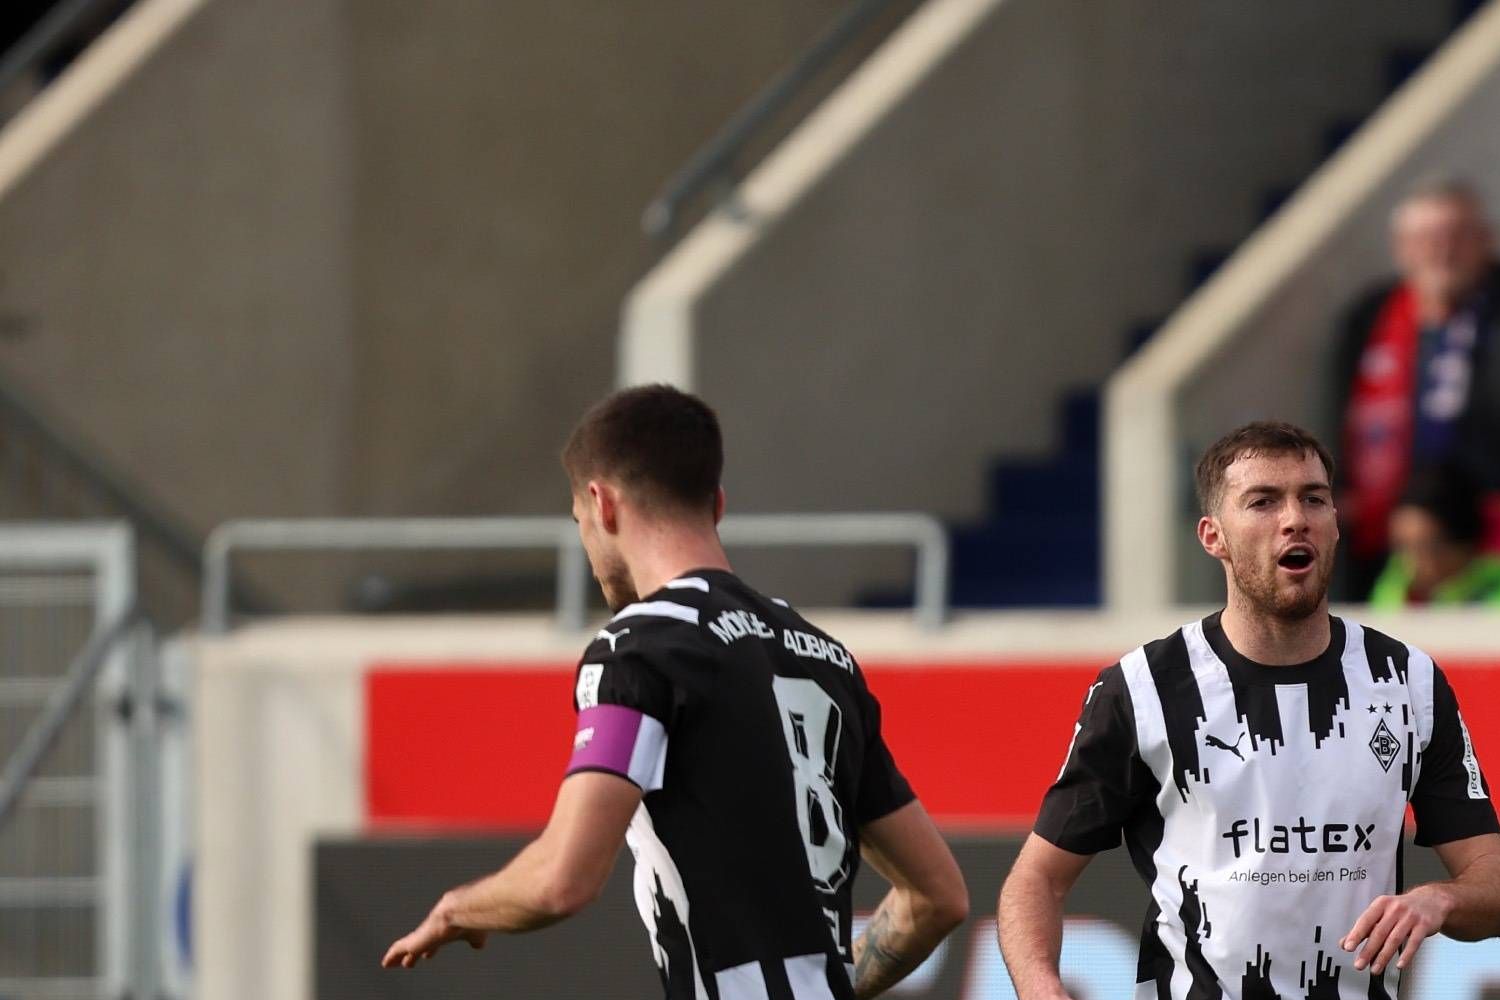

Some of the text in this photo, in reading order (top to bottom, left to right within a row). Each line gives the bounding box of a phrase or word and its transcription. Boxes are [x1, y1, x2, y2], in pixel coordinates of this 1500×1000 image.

[772, 674, 850, 894] 8
[1229, 869, 1287, 886] Anlegen
[1289, 869, 1310, 883] bei
